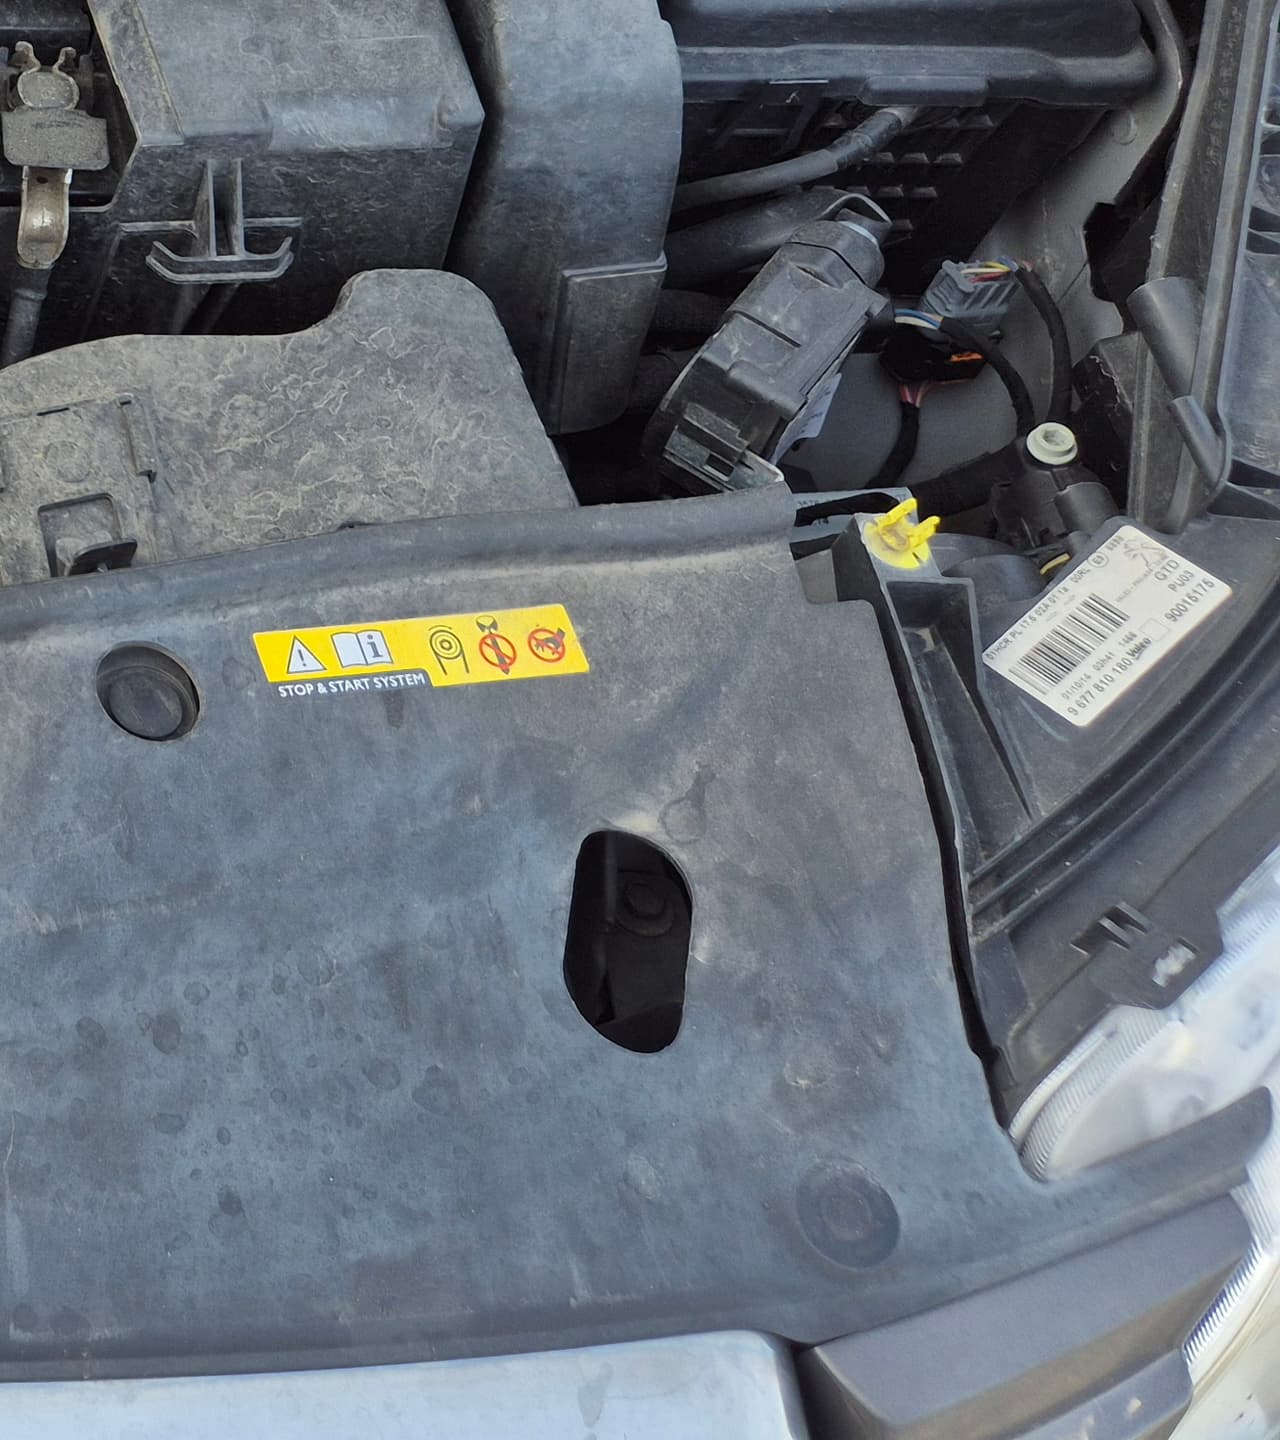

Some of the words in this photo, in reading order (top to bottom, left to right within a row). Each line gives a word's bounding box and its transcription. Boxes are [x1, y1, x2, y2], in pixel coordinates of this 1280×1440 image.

[1156, 559, 1180, 582] GTD
[1169, 570, 1194, 592] PU03
[278, 683, 314, 698] STOP
[318, 682, 328, 694] &
[328, 678, 371, 693] START
[374, 673, 426, 689] SYSTEM
[1067, 704, 1080, 717] 9
[1078, 689, 1094, 710] 677
[1095, 674, 1114, 692] 810
[1115, 658, 1133, 677] 180
